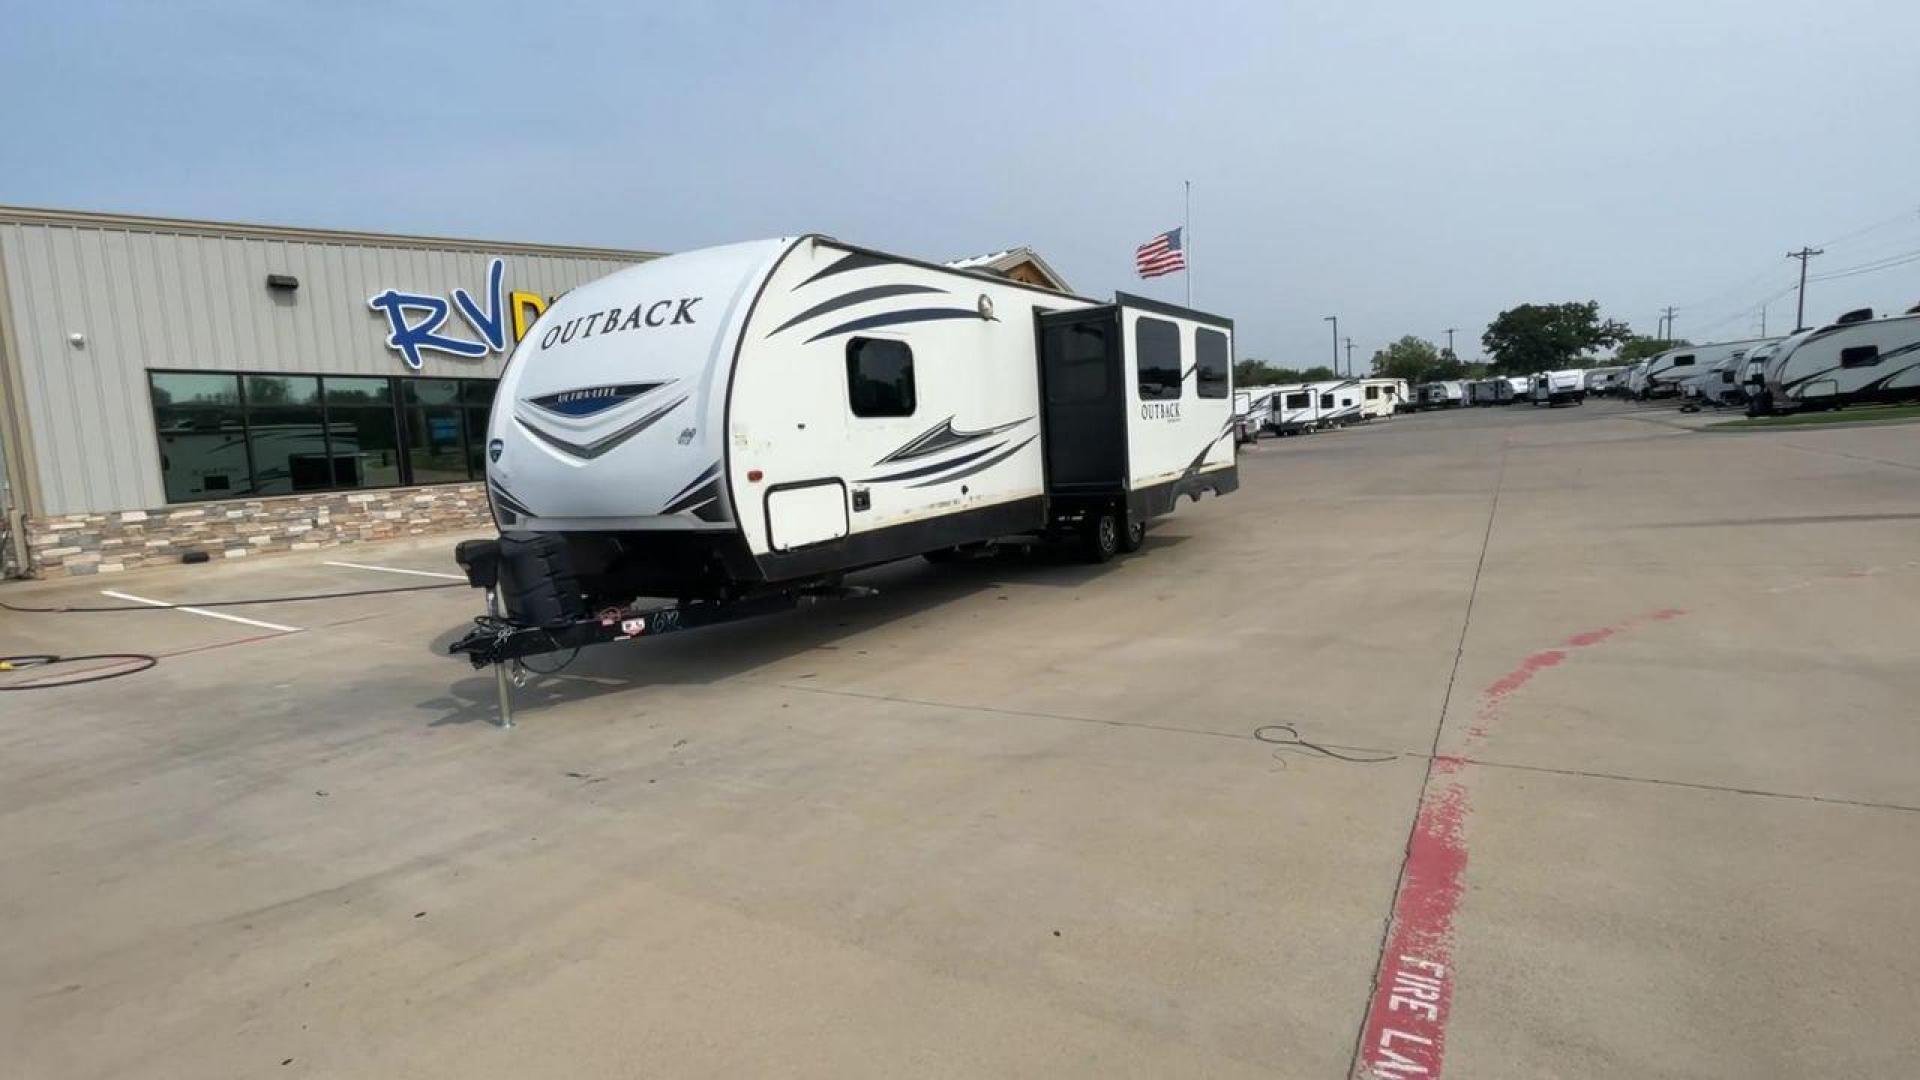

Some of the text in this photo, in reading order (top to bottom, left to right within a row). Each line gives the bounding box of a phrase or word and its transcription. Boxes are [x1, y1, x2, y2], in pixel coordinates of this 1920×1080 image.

[368, 258, 556, 369] RV D
[541, 297, 703, 350] OUTBACK
[1141, 403, 1181, 420] OUTBACK
[1389, 955, 1444, 1022] FIRE
